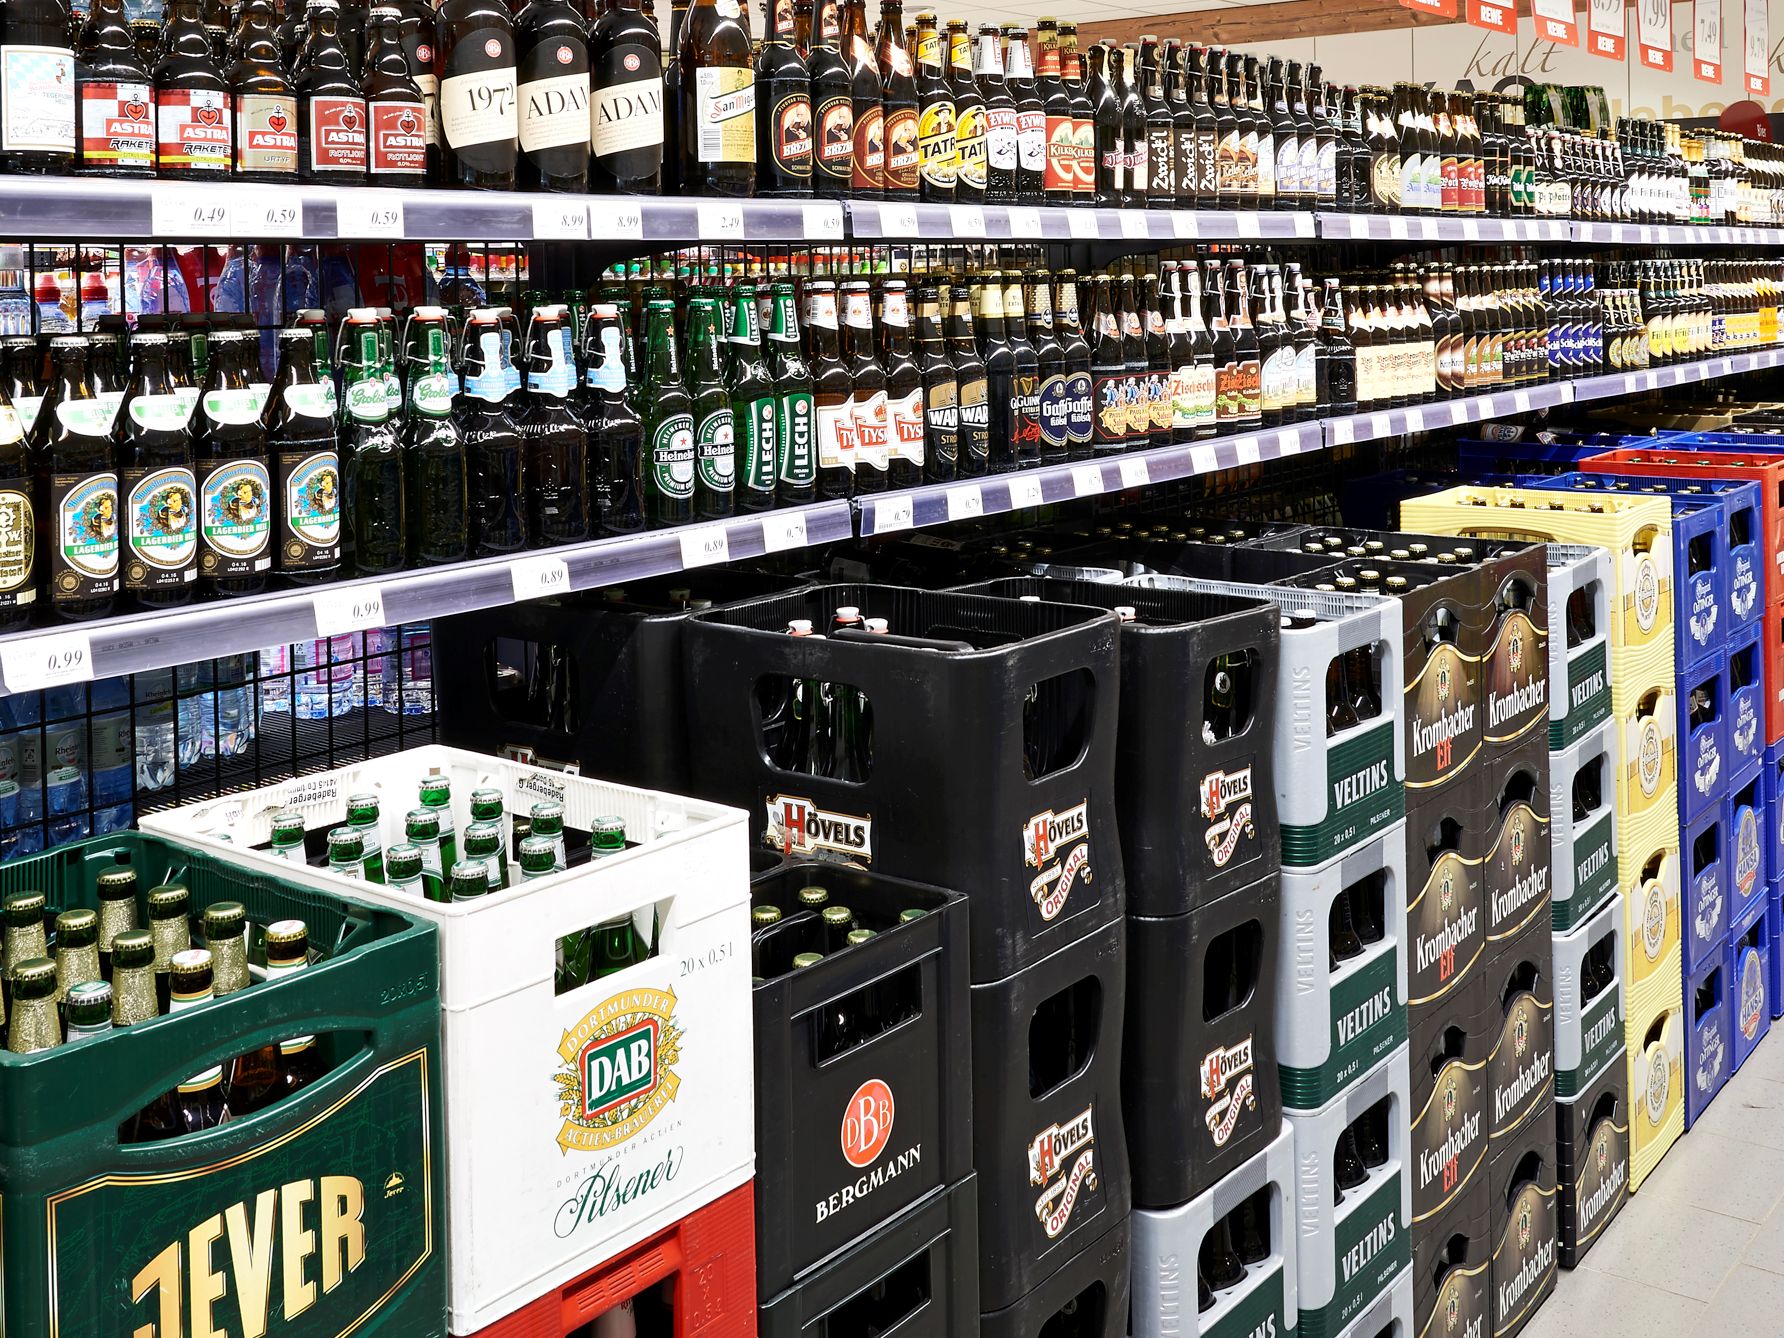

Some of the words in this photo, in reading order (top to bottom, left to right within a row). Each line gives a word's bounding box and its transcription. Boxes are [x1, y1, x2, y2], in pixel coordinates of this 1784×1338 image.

[1481, 5, 1503, 26] REWE
[1546, 21, 1567, 39] REWE
[1701, 18, 1717, 44] 7.49
[1597, 35, 1615, 53] REWE
[1648, 49, 1664, 65] REWE
[109, 122, 154, 135] ASTRA
[183, 127, 228, 140] ASTRA
[183, 143, 230, 155] RAKETE
[252, 134, 296, 148] ASTRA
[328, 132, 364, 144] ASTRA
[386, 136, 424, 147] ASTRA
[194, 206, 225, 223] 0.49
[266, 209, 296, 224] 0.59
[371, 211, 399, 226] 0.59
[561, 214, 584, 228] 8.99
[618, 214, 639, 228] 8.99
[667, 336, 678, 374] Heineken
[761, 421, 773, 474] LECH
[794, 416, 808, 467] LECH
[141, 535, 183, 545] LAGERBIER
[213, 525, 255, 535] LAGERBIER
[256, 522, 268, 531] HELL
[300, 515, 335, 526] LAGERBIER
[74, 542, 114, 555] LAGERBIER
[704, 538, 724, 554] 0.89
[541, 568, 564, 585] 0.89
[352, 600, 379, 619] 0.99
[48, 649, 83, 671] 0.99
[1489, 673, 1546, 729] Krombacher
[1571, 669, 1604, 707] VELTINS
[1413, 702, 1475, 757] Krombacher
[289, 787, 337, 806] Radeberger
[1208, 775, 1249, 822] HÖVELS
[1334, 759, 1388, 810] VELTINS
[783, 801, 866, 857] HÖVELS
[1034, 811, 1084, 870] HÖVELS
[1216, 806, 1250, 862] ORIGINAL
[1046, 847, 1086, 917] ORIGINAL
[1577, 841, 1609, 886] VELTINS
[1736, 851, 1759, 880] HANSA
[1491, 862, 1548, 928] Krombacher
[1416, 904, 1477, 974] Krombacher
[680, 957, 695, 977] 20
[565, 992, 669, 1053] DORTMUNDER
[1337, 985, 1391, 1047] VELTINS
[1584, 1006, 1616, 1054] VELTINS
[1741, 992, 1763, 1026] HANSA
[590, 1037, 651, 1095] DAB
[1207, 1044, 1249, 1101] HÖVELS
[1494, 1048, 1550, 1124] Krombacher
[565, 1081, 674, 1147] ACTIEN-BRAUEREI
[1217, 1080, 1251, 1141] ORIGINAL
[556, 1143, 637, 1188] DORTMUNDER
[642, 1120, 683, 1144] ACTIEN
[1038, 1120, 1089, 1187] HÖVELS
[1420, 1109, 1480, 1190] Krombacher
[553, 1145, 684, 1239] Pilsener
[815, 1143, 921, 1224] BERGMANN
[1050, 1155, 1091, 1232] ORIGINAL
[1579, 1158, 1626, 1233] Krombacher
[131, 1174, 366, 1338] JEVER
[1341, 1211, 1396, 1283] VELTINS
[1499, 1237, 1554, 1323] Krombacher
